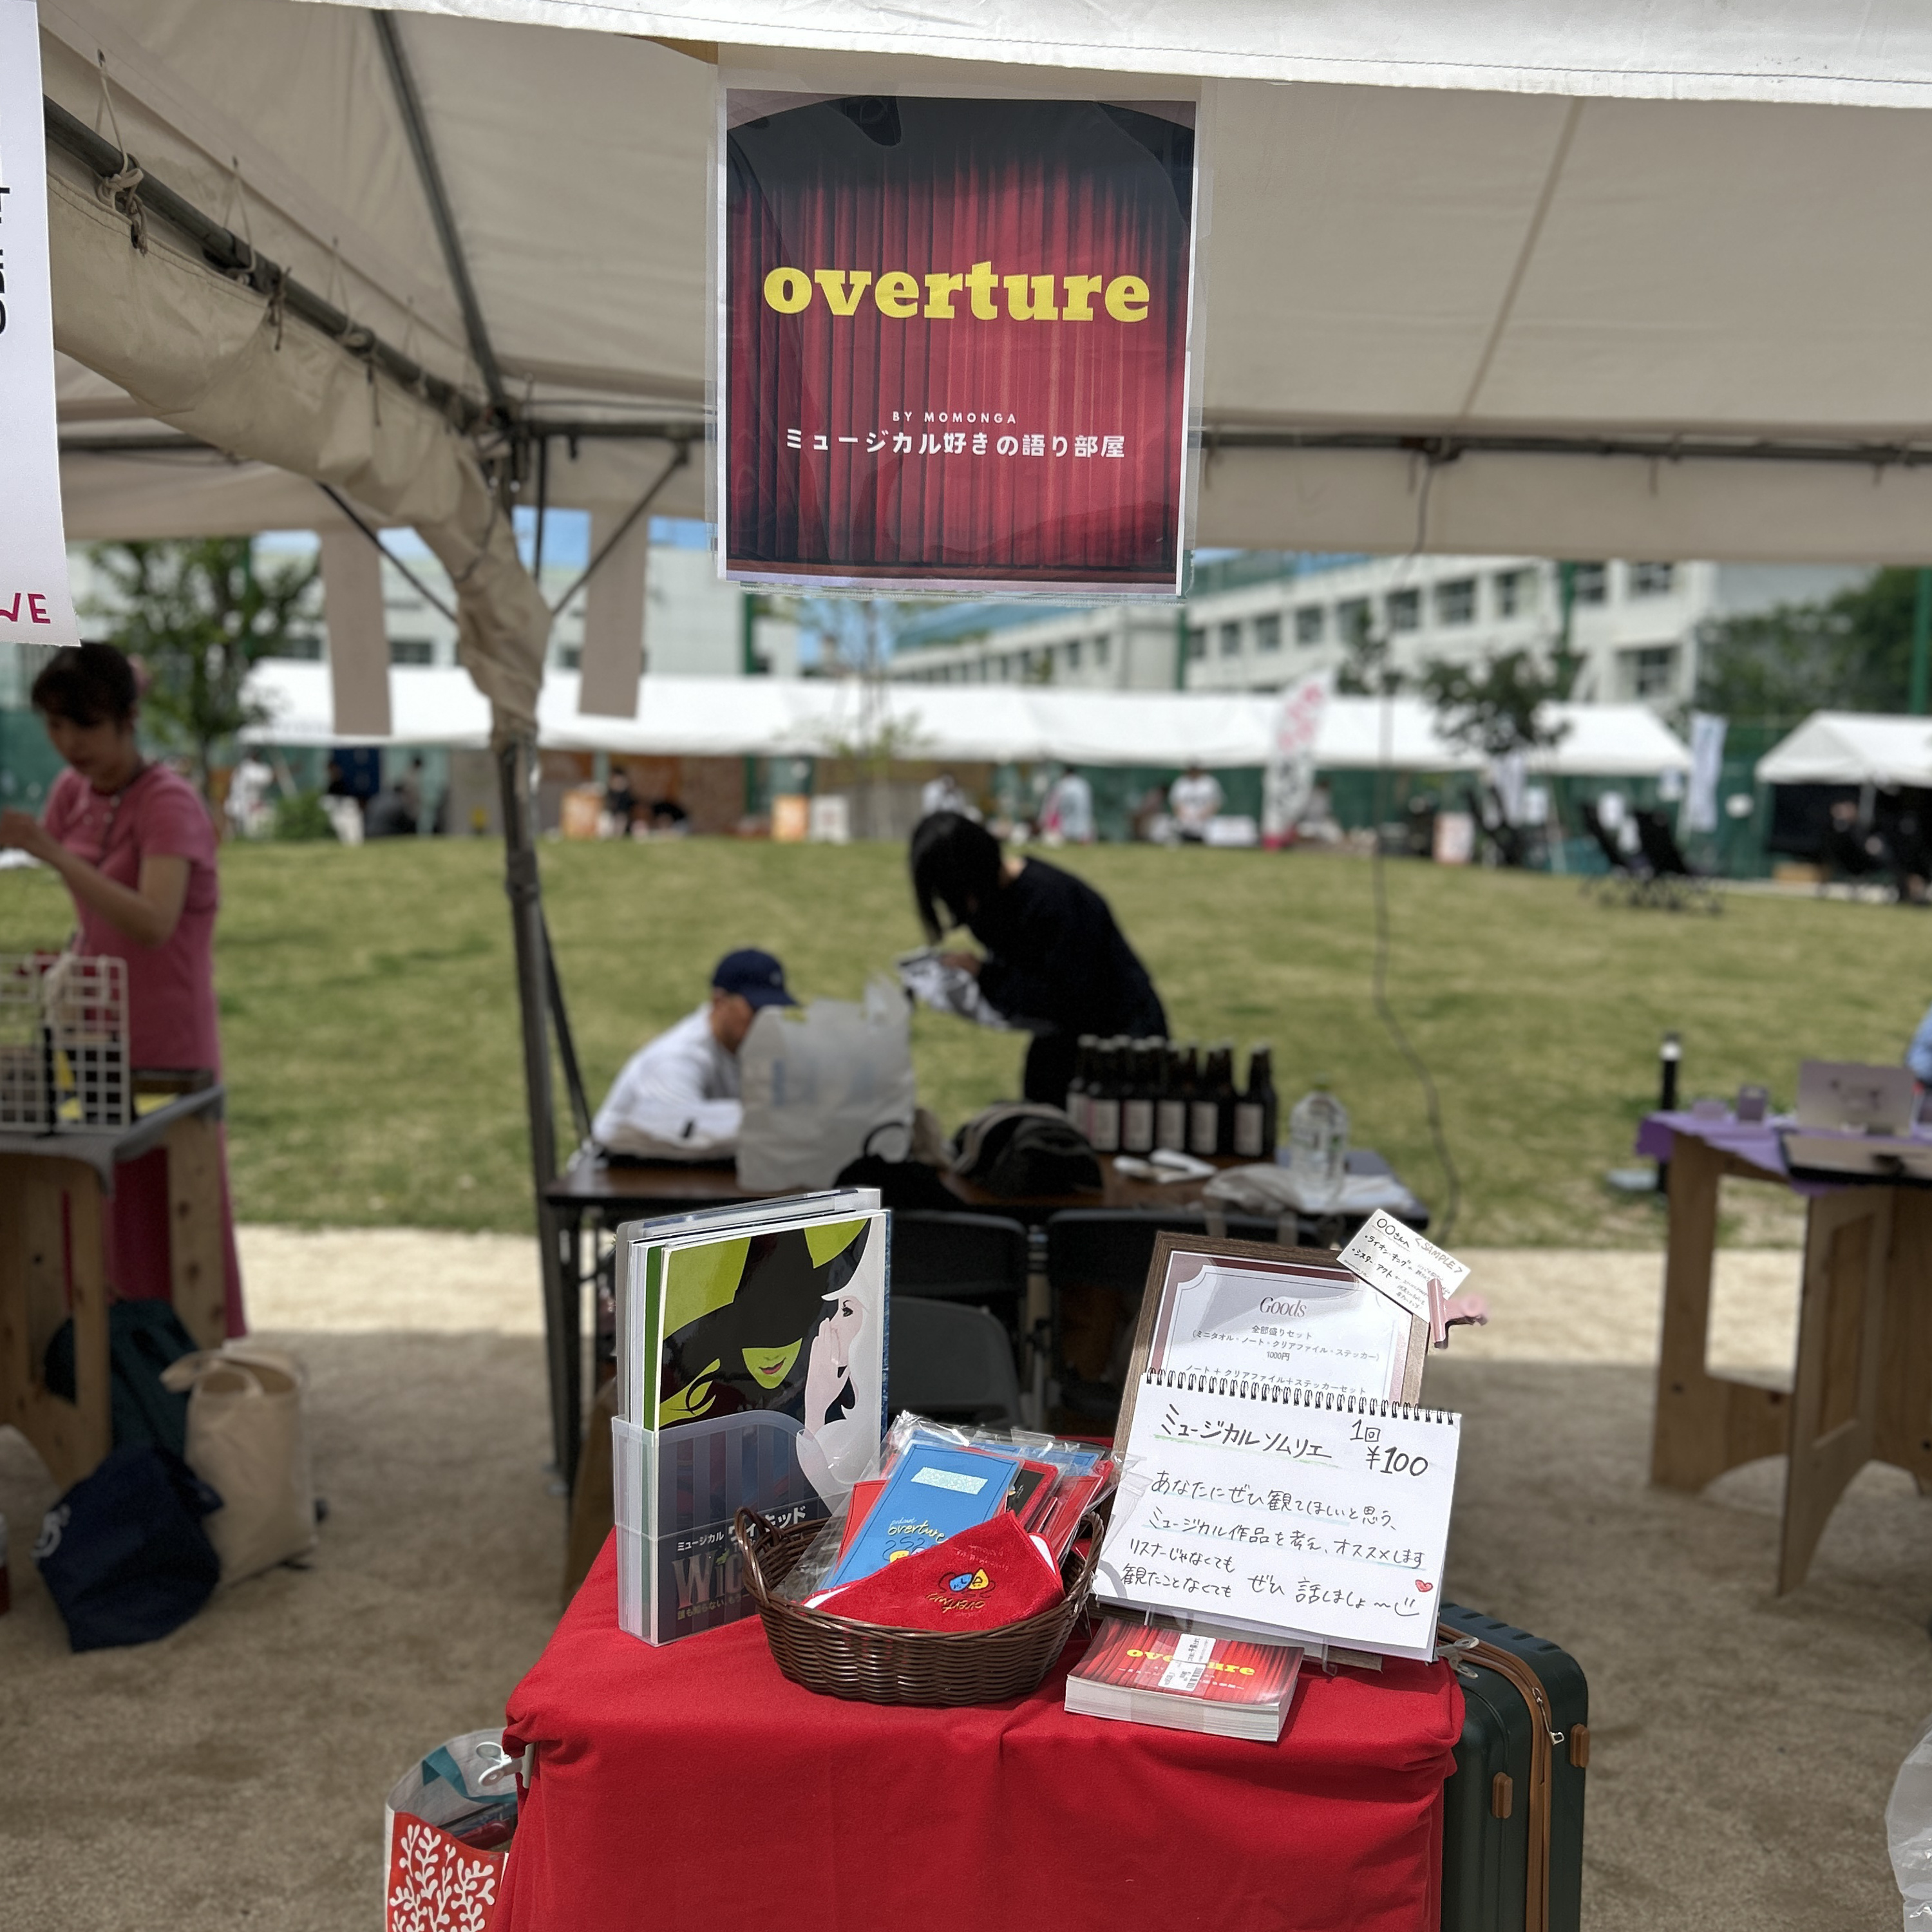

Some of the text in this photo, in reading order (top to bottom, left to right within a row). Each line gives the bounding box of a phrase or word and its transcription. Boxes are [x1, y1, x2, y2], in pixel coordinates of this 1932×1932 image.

[763, 261, 1150, 323] overture
[893, 411, 1016, 424] BY MOMONGA
[786, 428, 1126, 459] ミュージカル好きの語り部屋
[1259, 1296, 1307, 1318] Goods
[1252, 1325, 1312, 1340] 全部盛りセット
[1267, 1350, 1290, 1361] 1000円
[1349, 1419, 1380, 1443] 1回
[1366, 1446, 1428, 1477] ¥100
[677, 1531, 724, 1551] ミュージカル
[888, 1519, 949, 1544] overture
[1130, 1539, 1235, 1573] リスナーじゃなくても
[1121, 1563, 1232, 1598] 観たことなくても
